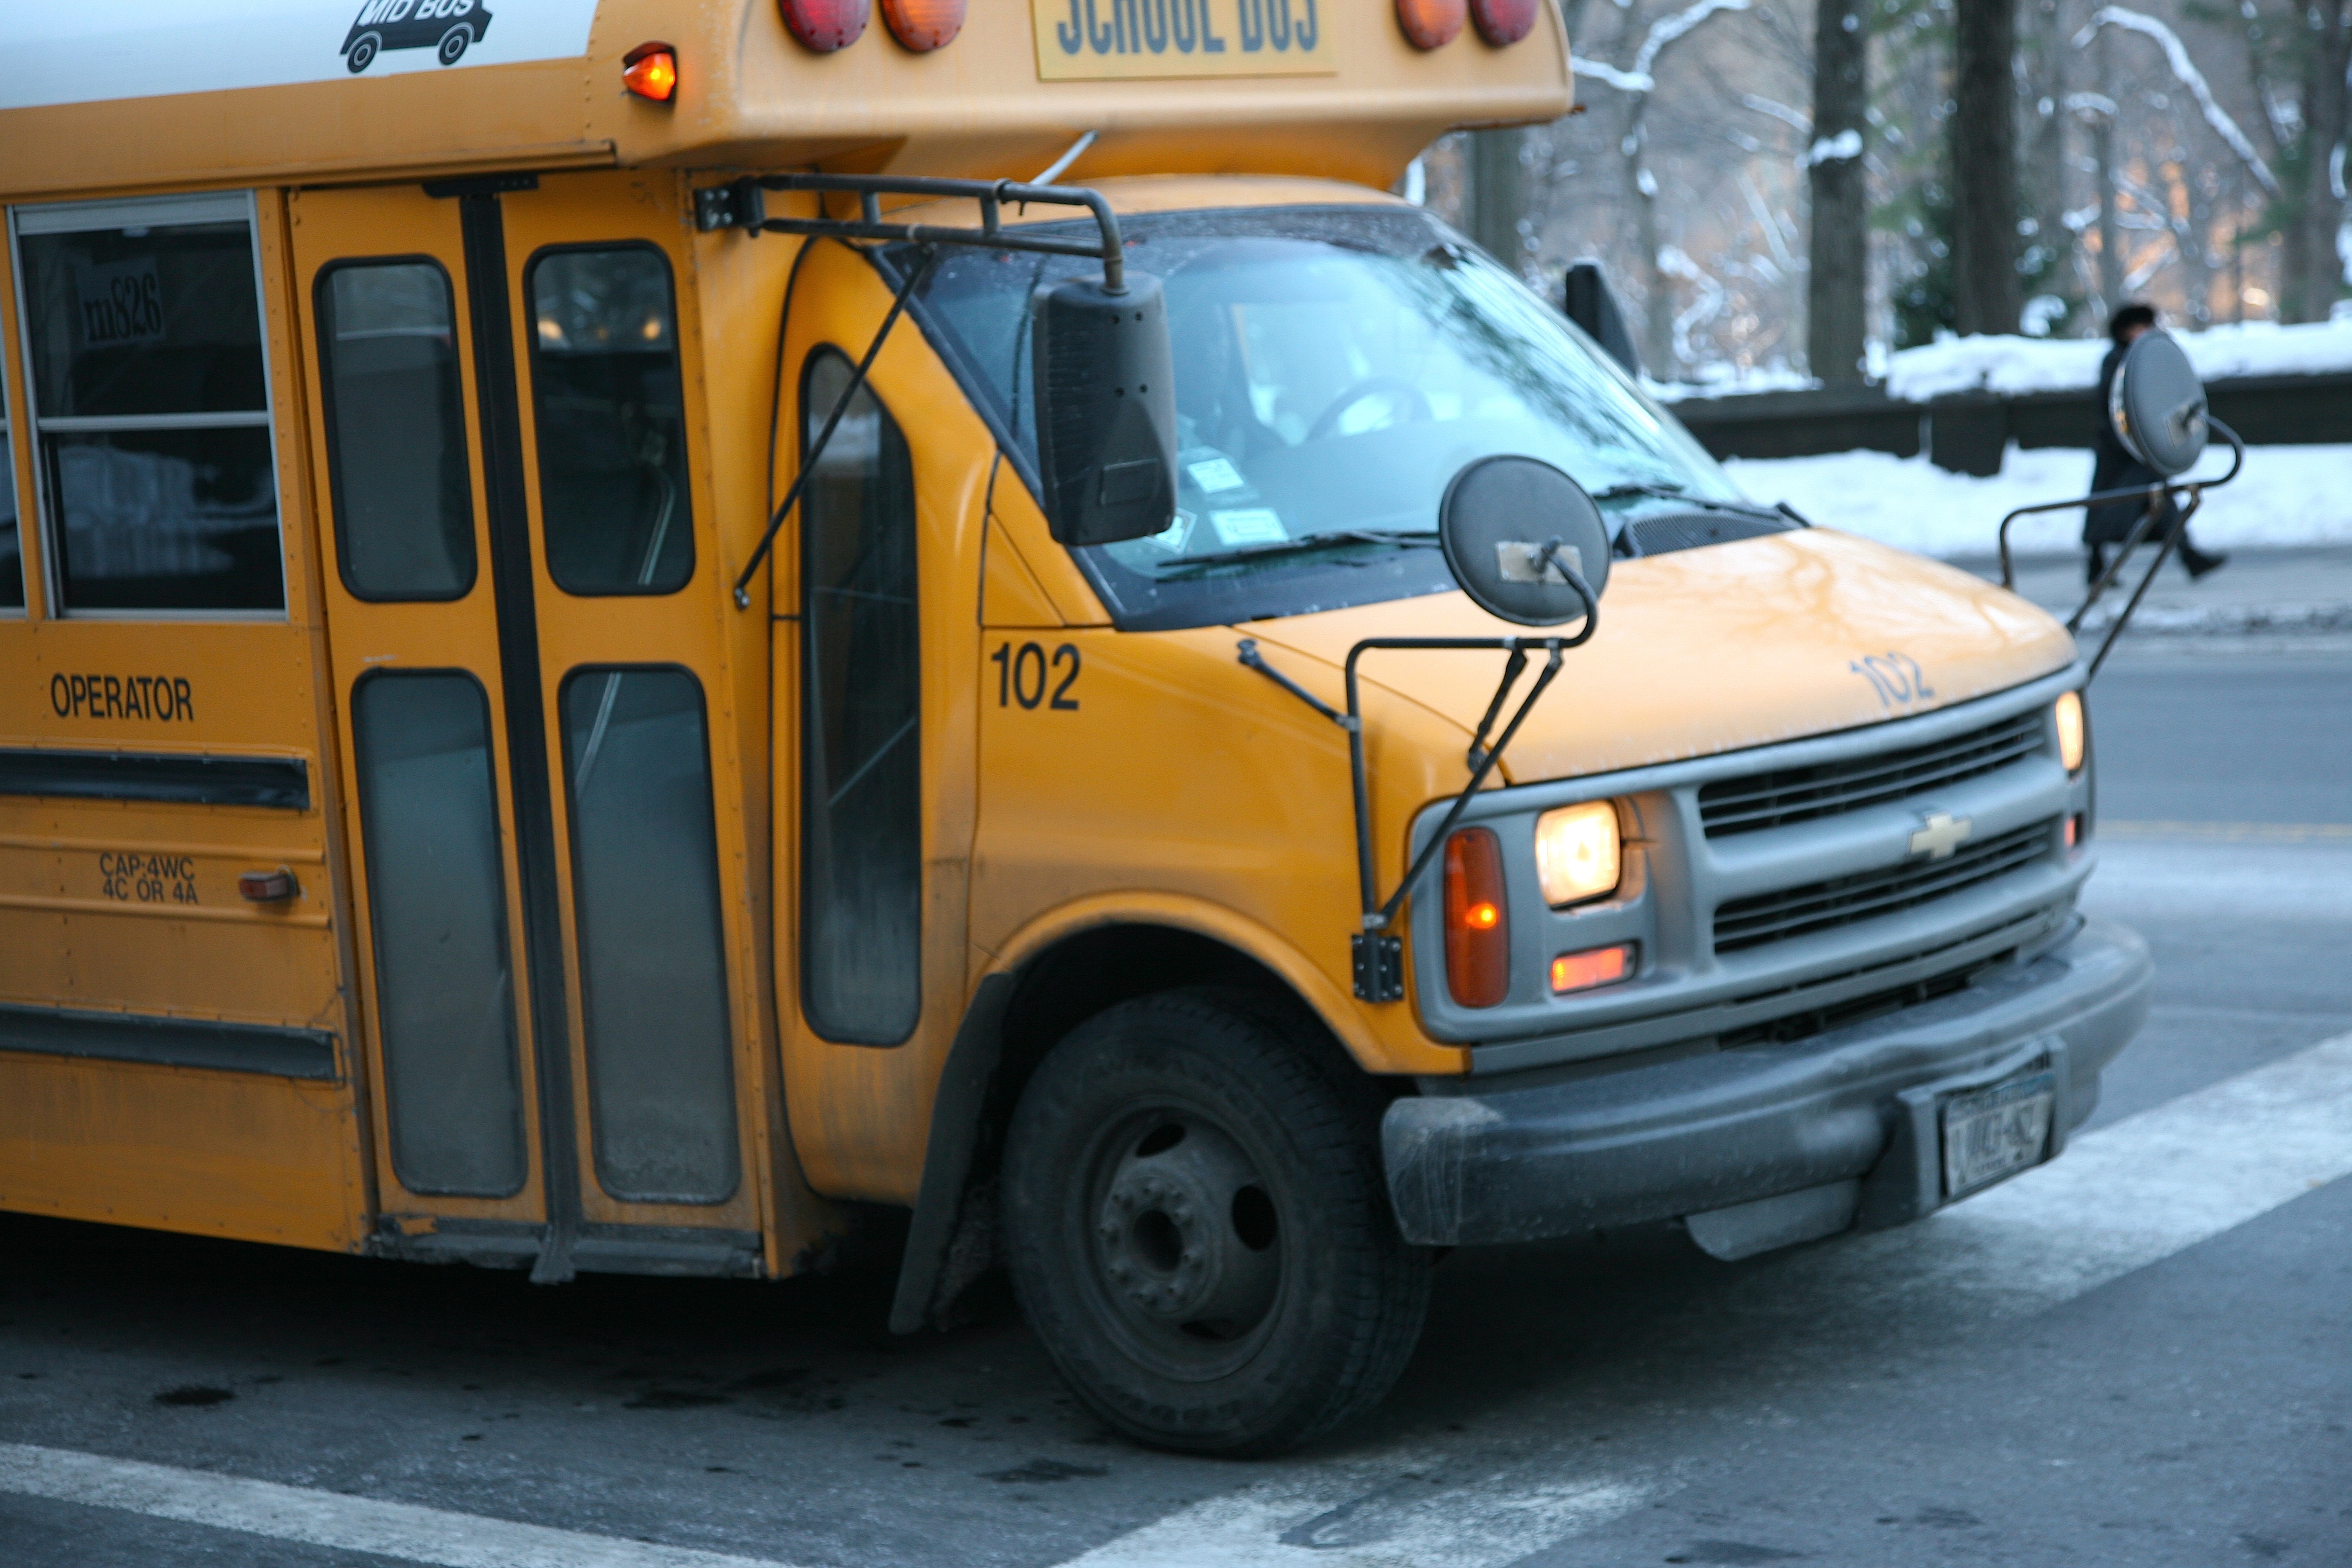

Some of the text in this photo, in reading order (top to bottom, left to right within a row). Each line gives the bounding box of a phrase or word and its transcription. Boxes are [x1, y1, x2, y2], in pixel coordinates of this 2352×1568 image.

[355, 0, 475, 26] MID BUS
[51, 673, 194, 721] OPERATOR
[991, 641, 1081, 709] 102
[1850, 651, 1935, 708] 102
[103, 878, 199, 905] 4C OR 4A
